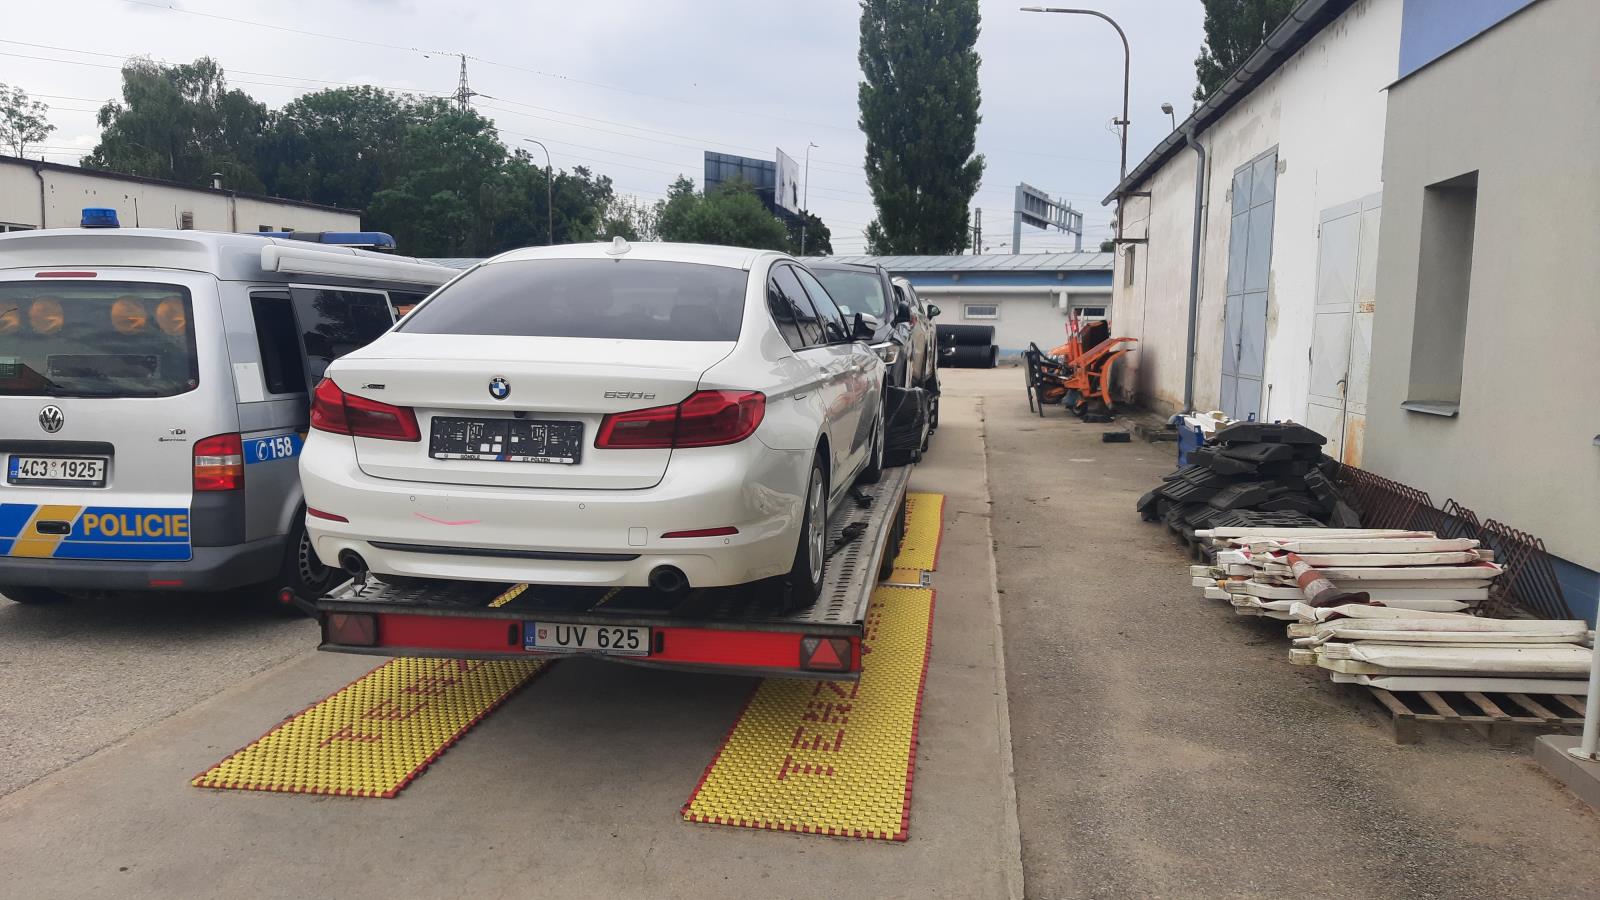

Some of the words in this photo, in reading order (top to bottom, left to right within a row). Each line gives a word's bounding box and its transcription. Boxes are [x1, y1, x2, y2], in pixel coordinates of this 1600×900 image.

[269, 437, 292, 458] 158
[22, 460, 48, 476] 4C3
[60, 461, 97, 478] 1925
[83, 513, 188, 537] POLICIE
[556, 625, 587, 647] UV
[597, 628, 640, 649] 625
